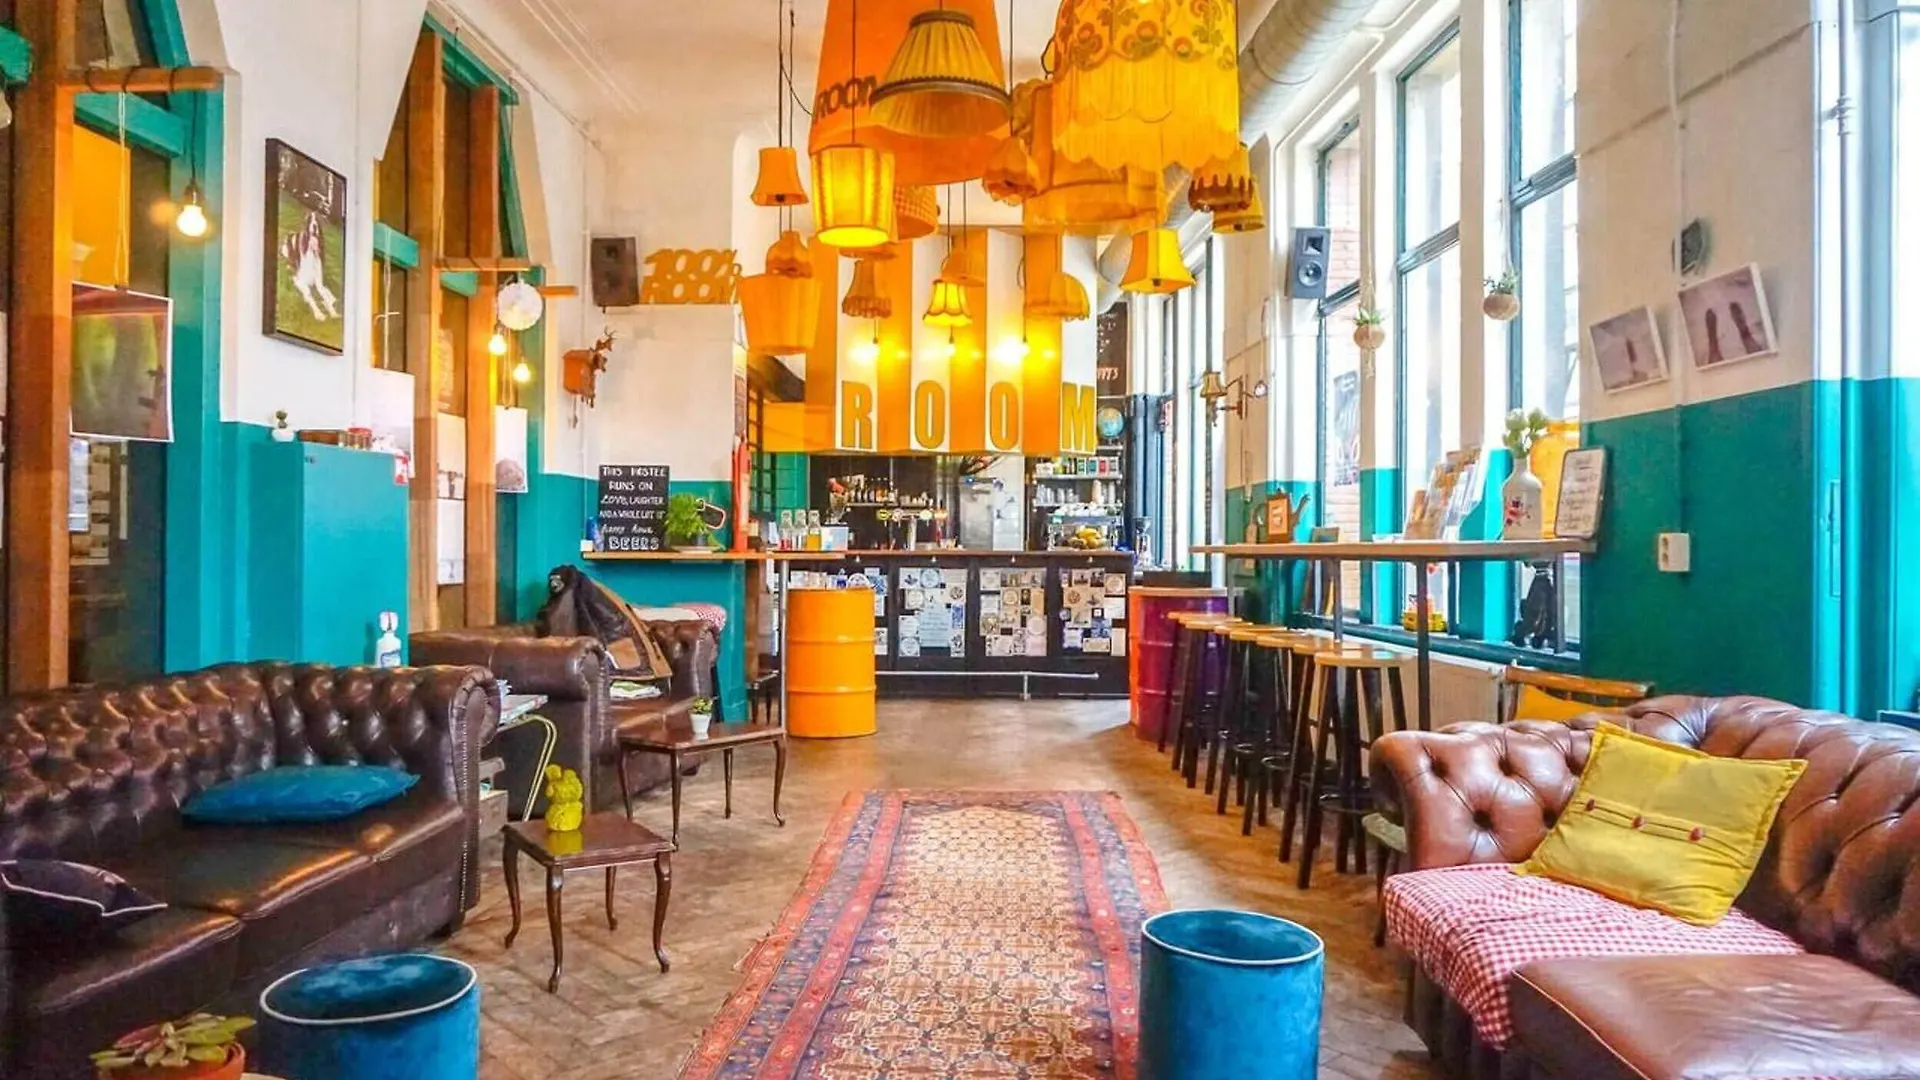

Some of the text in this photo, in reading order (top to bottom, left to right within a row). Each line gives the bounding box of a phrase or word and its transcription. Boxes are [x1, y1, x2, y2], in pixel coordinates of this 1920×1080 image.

[841, 379, 1096, 451] ROOM
[602, 466, 667, 477] THIS HOSTEL
[608, 480, 653, 491] RUNS ON
[608, 535, 660, 551] BEERS
